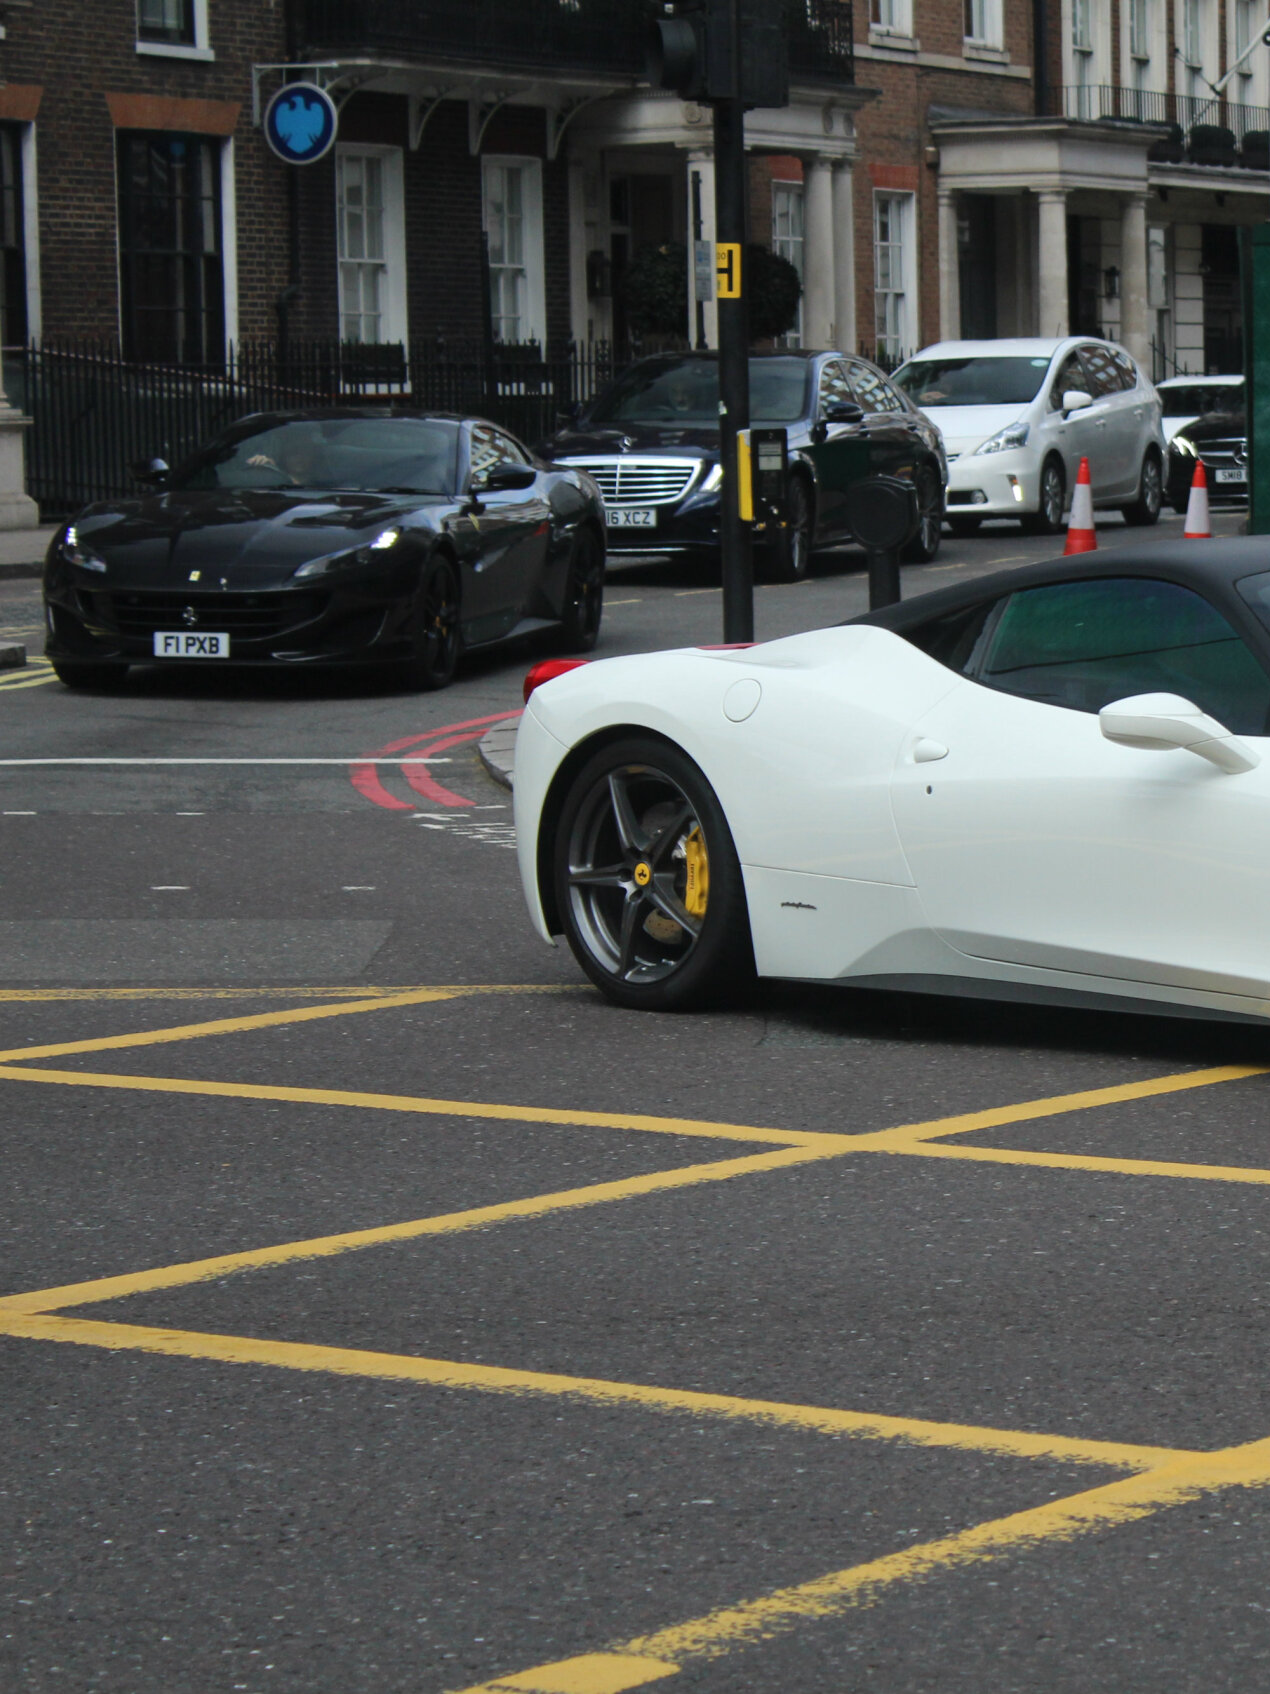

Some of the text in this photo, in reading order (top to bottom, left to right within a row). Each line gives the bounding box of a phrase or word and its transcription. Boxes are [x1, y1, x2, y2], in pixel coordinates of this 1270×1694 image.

[623, 511, 650, 525] XCZ
[164, 635, 220, 654] F1 PXB
